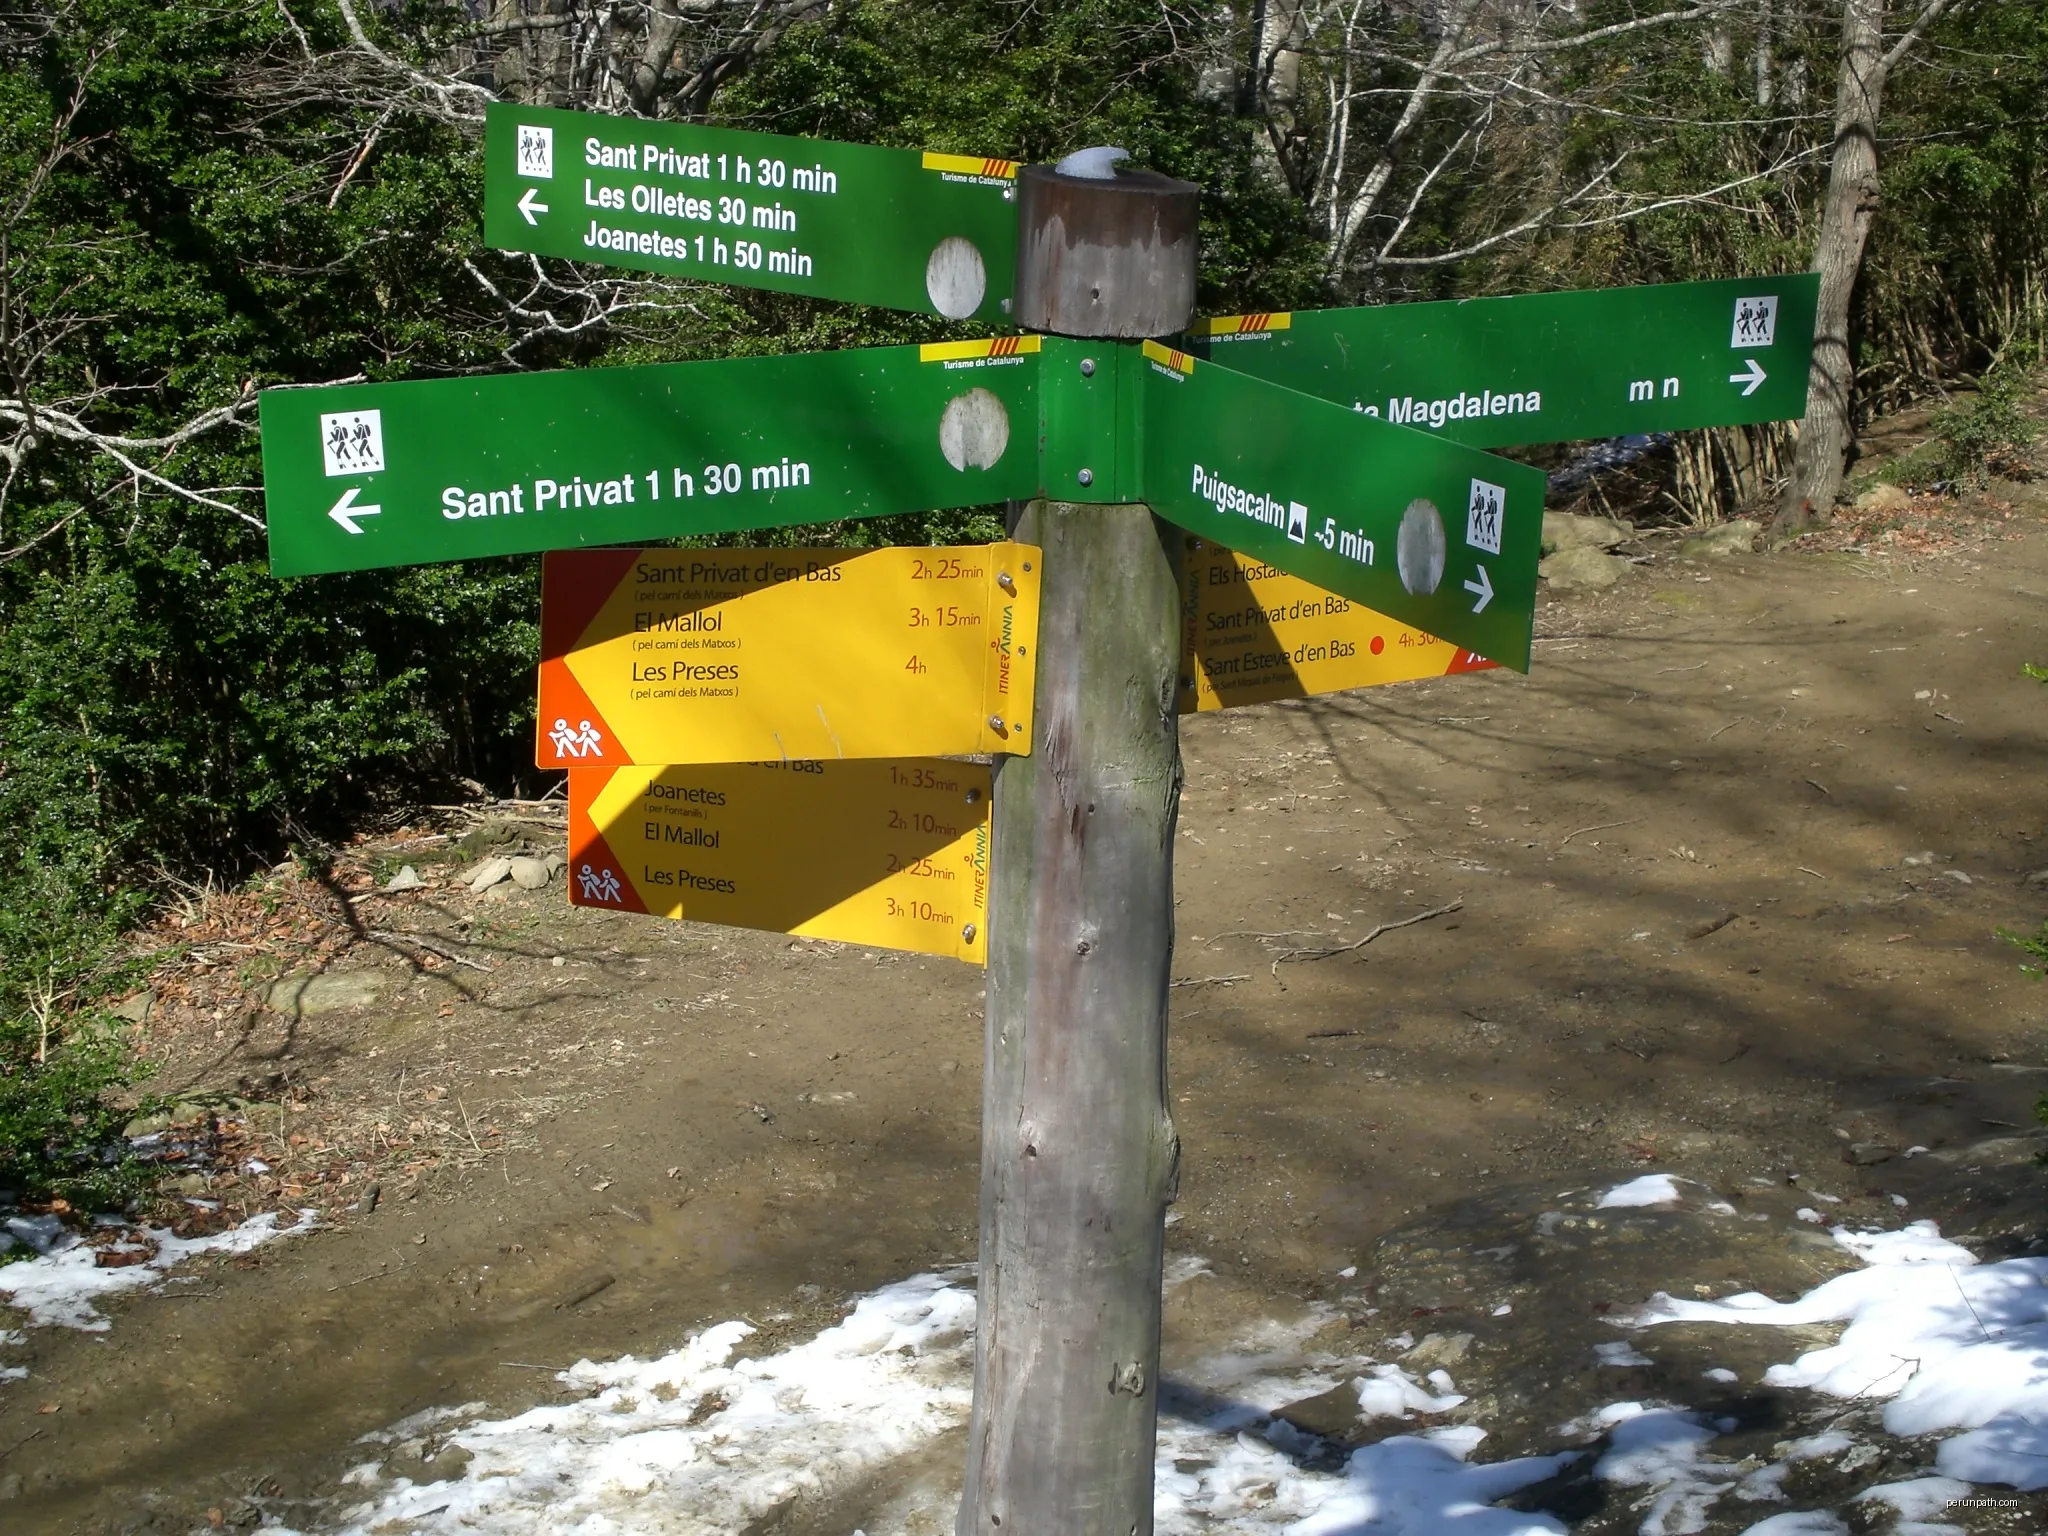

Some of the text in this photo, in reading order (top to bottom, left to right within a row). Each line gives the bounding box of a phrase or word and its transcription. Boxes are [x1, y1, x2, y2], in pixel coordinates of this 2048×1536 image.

[585, 137, 837, 194] Sant Privat 1 h 30 min
[941, 172, 967, 183] Turisme
[968, 175, 977, 183] de
[585, 178, 796, 232] Les Olletes 30 min
[583, 220, 812, 277] Joanetes 1 h 50 min
[1223, 333, 1233, 342] de
[1234, 332, 1272, 343] Catalunya
[943, 356, 1024, 370] Turisme de Catalunya
[1389, 389, 1541, 429] Magdalena
[441, 457, 811, 521] Sant Privat 1 h 30 min
[1192, 464, 1285, 529] Puigsacalm
[1339, 528, 1375, 566] min
[636, 559, 984, 584] Sant Privat d'en Bas 2h 25min
[1209, 566, 1229, 586] Els
[634, 606, 981, 633] El Mallol 3h 15min
[1207, 596, 1350, 631] Sant Privat d'en Bas
[681, 639, 700, 649] dels
[1204, 658, 1243, 677] Sant
[1243, 652, 1291, 671] Esteve
[1294, 644, 1326, 664] d'en
[1330, 640, 1356, 659] Bas
[1399, 632, 1415, 648] 4h
[632, 655, 927, 682] Les Preses 4h
[678, 687, 697, 698] dels
[890, 766, 908, 786] 1h
[912, 768, 959, 792] 35min
[644, 779, 957, 837] Joanetes 2h 10min
[645, 822, 955, 881] El Mallol 2h 25min
[645, 865, 954, 925] Les Preses 3h 10min
